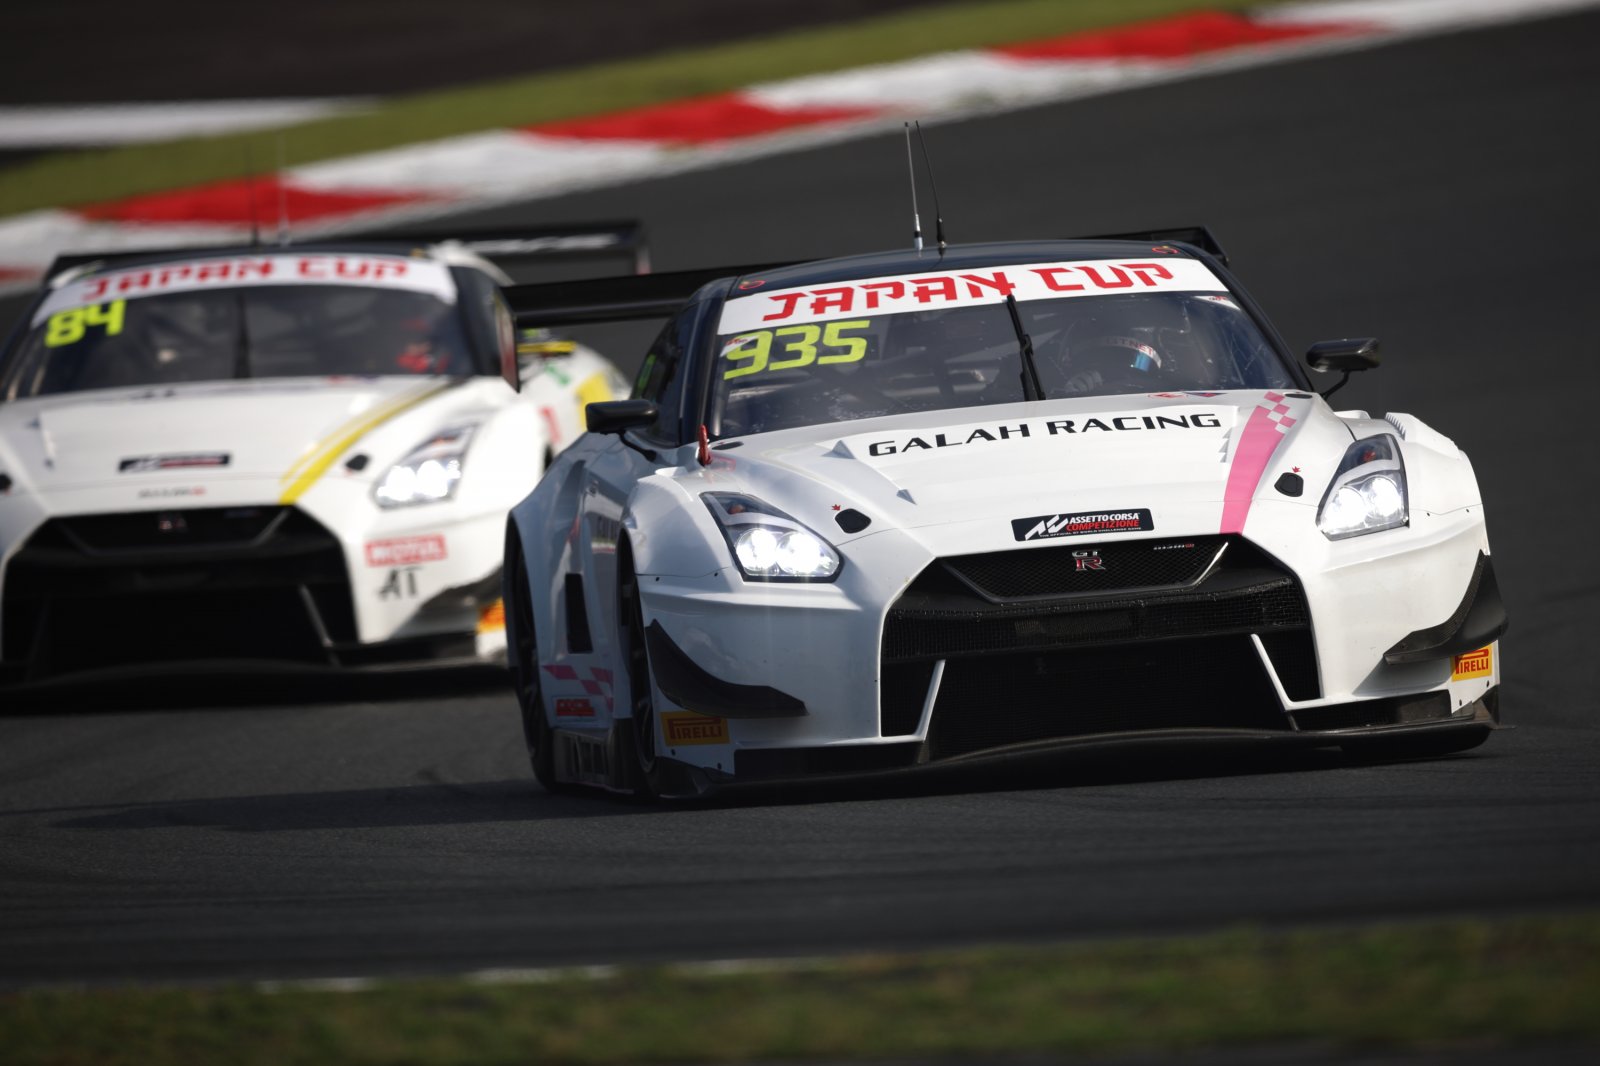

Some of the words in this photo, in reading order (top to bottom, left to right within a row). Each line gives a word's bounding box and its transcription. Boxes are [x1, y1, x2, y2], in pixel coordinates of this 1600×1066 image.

[82, 257, 275, 301] JAPAN
[297, 257, 409, 280] CUP
[762, 270, 1016, 322] JAPAN
[1028, 263, 1175, 292] CUP
[44, 299, 127, 348] 84
[722, 319, 871, 381] 935
[868, 423, 1032, 458] GALAH
[1046, 413, 1222, 436] RACING
[1065, 519, 1140, 532] COMPETIZIONE
[1069, 514, 1110, 525] ASSETTO
[1109, 512, 1140, 521] CORSA
[1455, 649, 1489, 675] PIRELLI
[667, 716, 723, 740] PIRELLI
